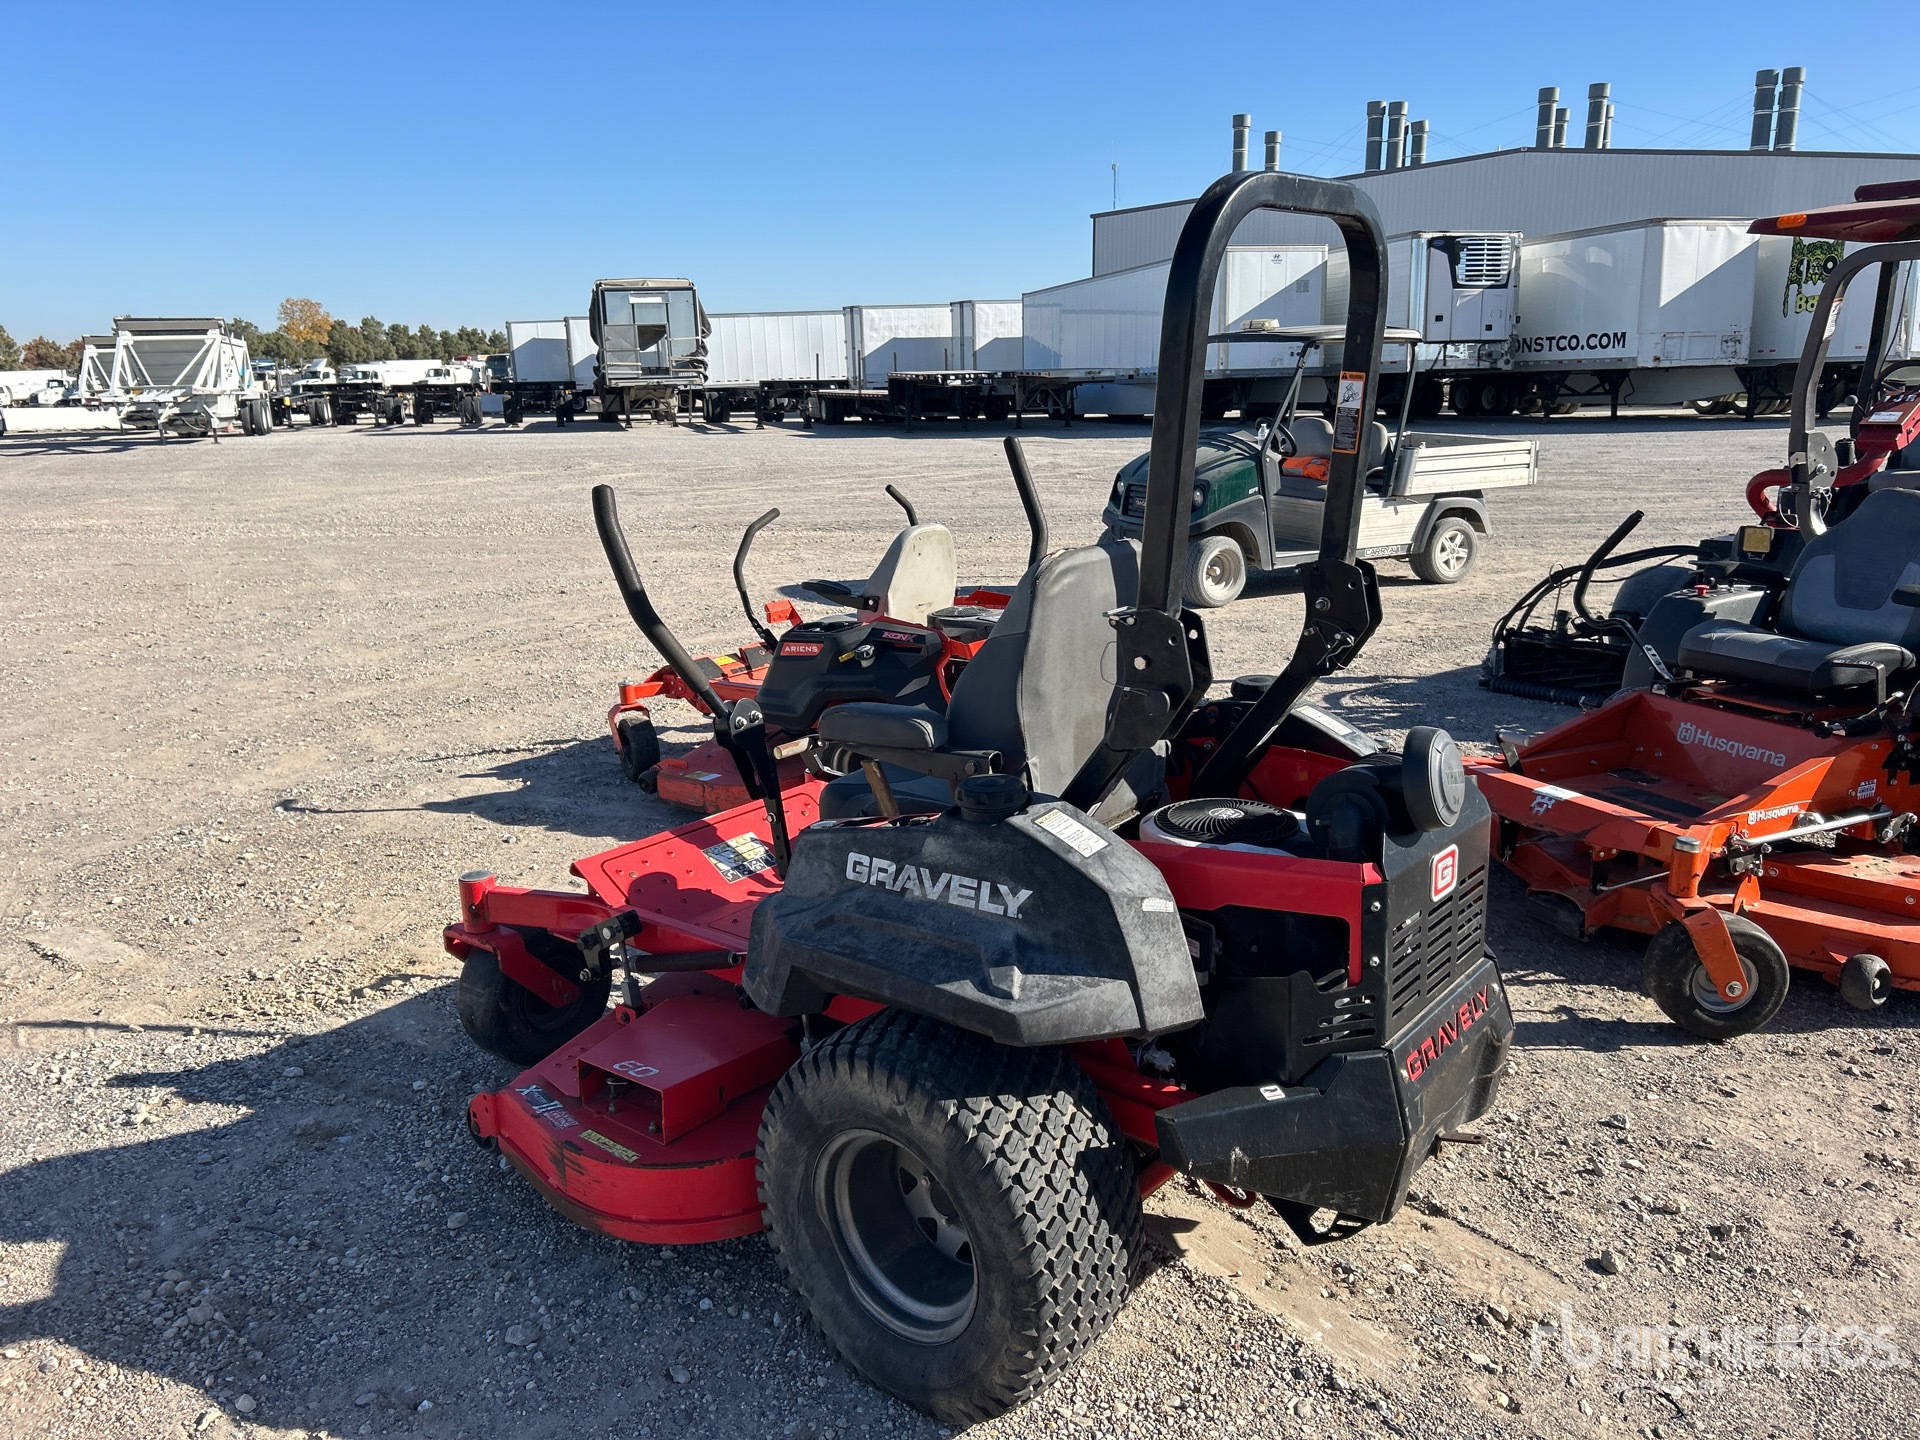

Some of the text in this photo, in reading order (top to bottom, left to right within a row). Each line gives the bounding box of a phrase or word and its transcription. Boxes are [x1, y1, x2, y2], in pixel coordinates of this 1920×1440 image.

[784, 645, 818, 653] ARIENS
[1694, 728, 1786, 767] Husqvarna
[1756, 805, 1799, 822] Husqvarna
[845, 852, 1034, 919] GRAVELY
[1406, 983, 1490, 1082] GRAVELY
[612, 1060, 660, 1078] 60
